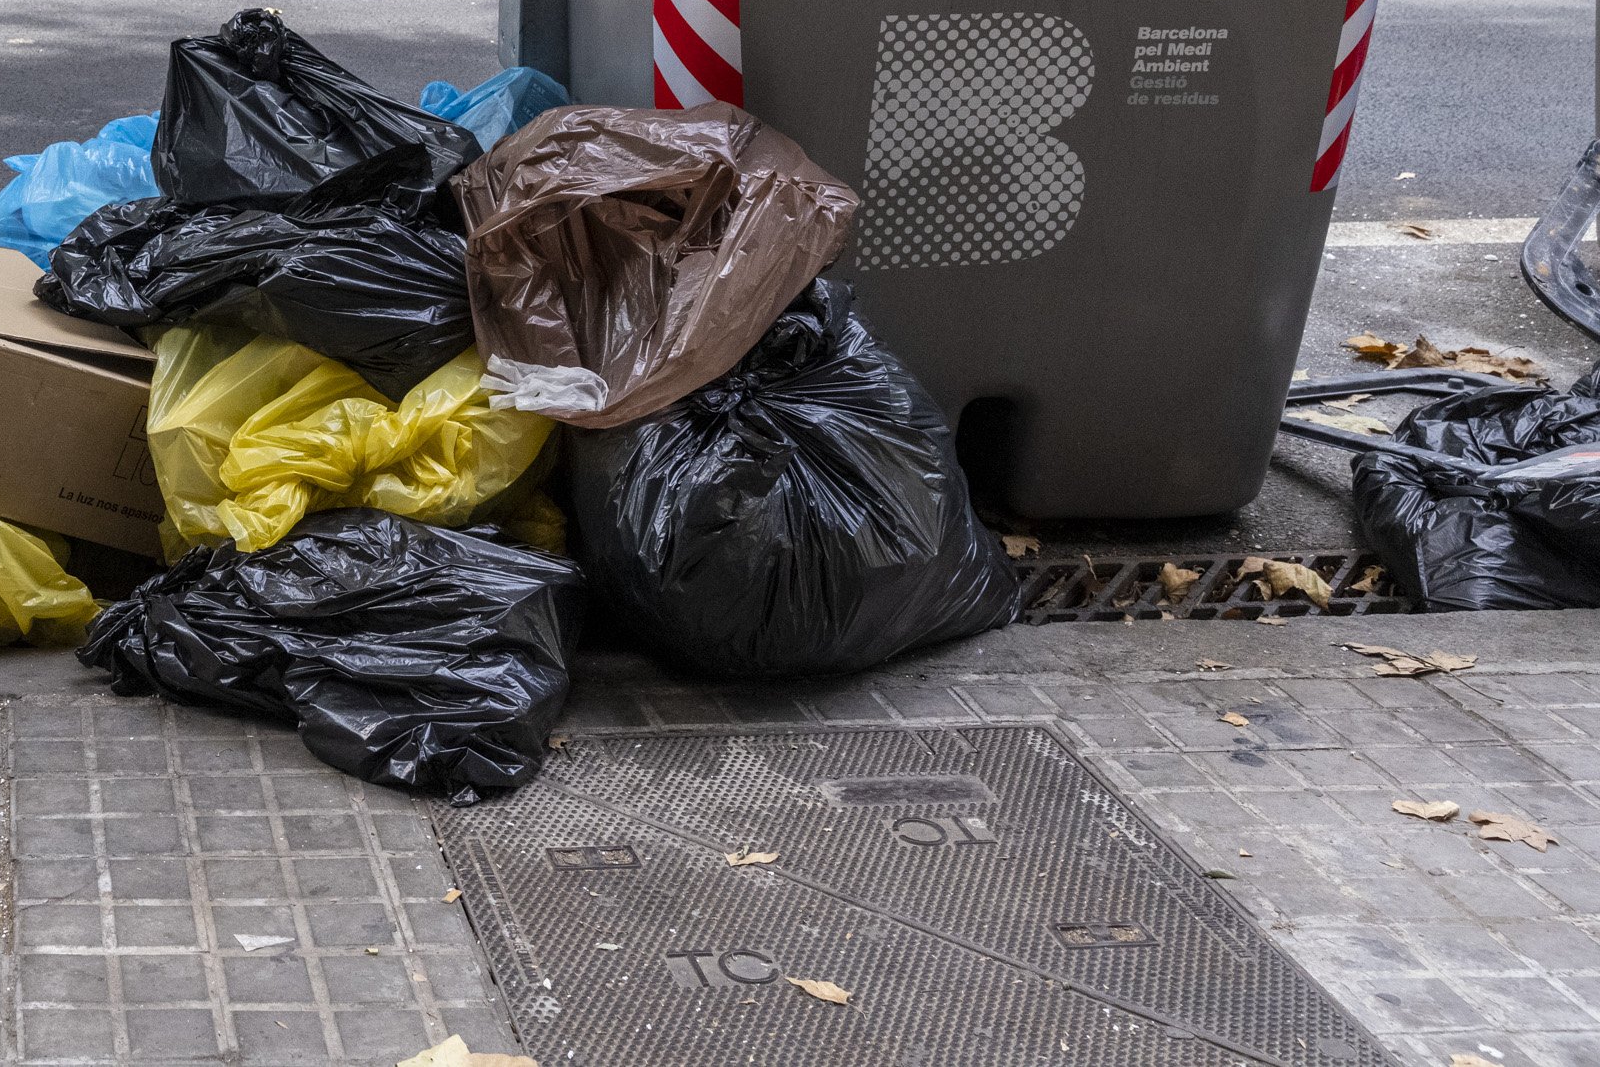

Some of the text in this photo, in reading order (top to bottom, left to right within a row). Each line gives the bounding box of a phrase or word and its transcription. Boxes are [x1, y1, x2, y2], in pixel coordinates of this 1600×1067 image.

[1137, 26, 1229, 40] Barcelona
[1133, 42, 1213, 60] pel Medi
[1131, 59, 1210, 73] Ambient
[1129, 75, 1188, 89] Gestió
[1126, 92, 1220, 106] de residus
[58, 487, 74, 502] La
[76, 491, 94, 507] luz
[96, 499, 119, 513] nos
[892, 814, 999, 847] TC
[666, 949, 780, 988] TC
